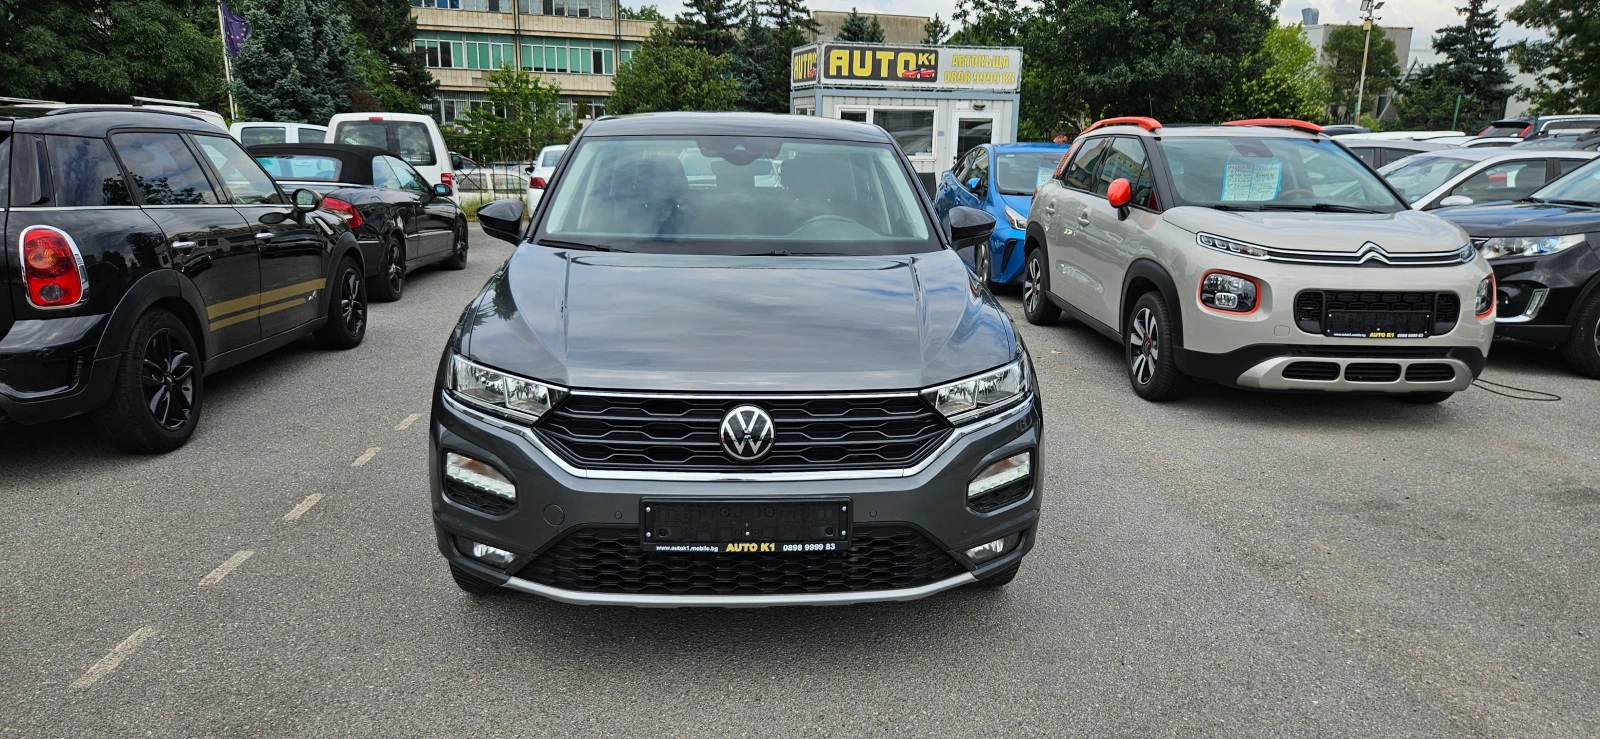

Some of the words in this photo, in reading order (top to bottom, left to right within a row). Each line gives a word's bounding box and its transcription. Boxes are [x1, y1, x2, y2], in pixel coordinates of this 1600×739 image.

[794, 52, 813, 80] AUTO
[829, 49, 917, 77] AUTO
[918, 52, 936, 66] K1
[952, 55, 1009, 68] АВТОКЪЩА
[944, 70, 971, 83] 0898
[973, 71, 1001, 84] 9999
[1002, 72, 1016, 85] 83
[725, 542, 759, 552] AUTO
[760, 542, 775, 552] K1
[783, 543, 802, 551] 0898
[804, 543, 824, 551] 9999
[825, 543, 836, 551] 83
